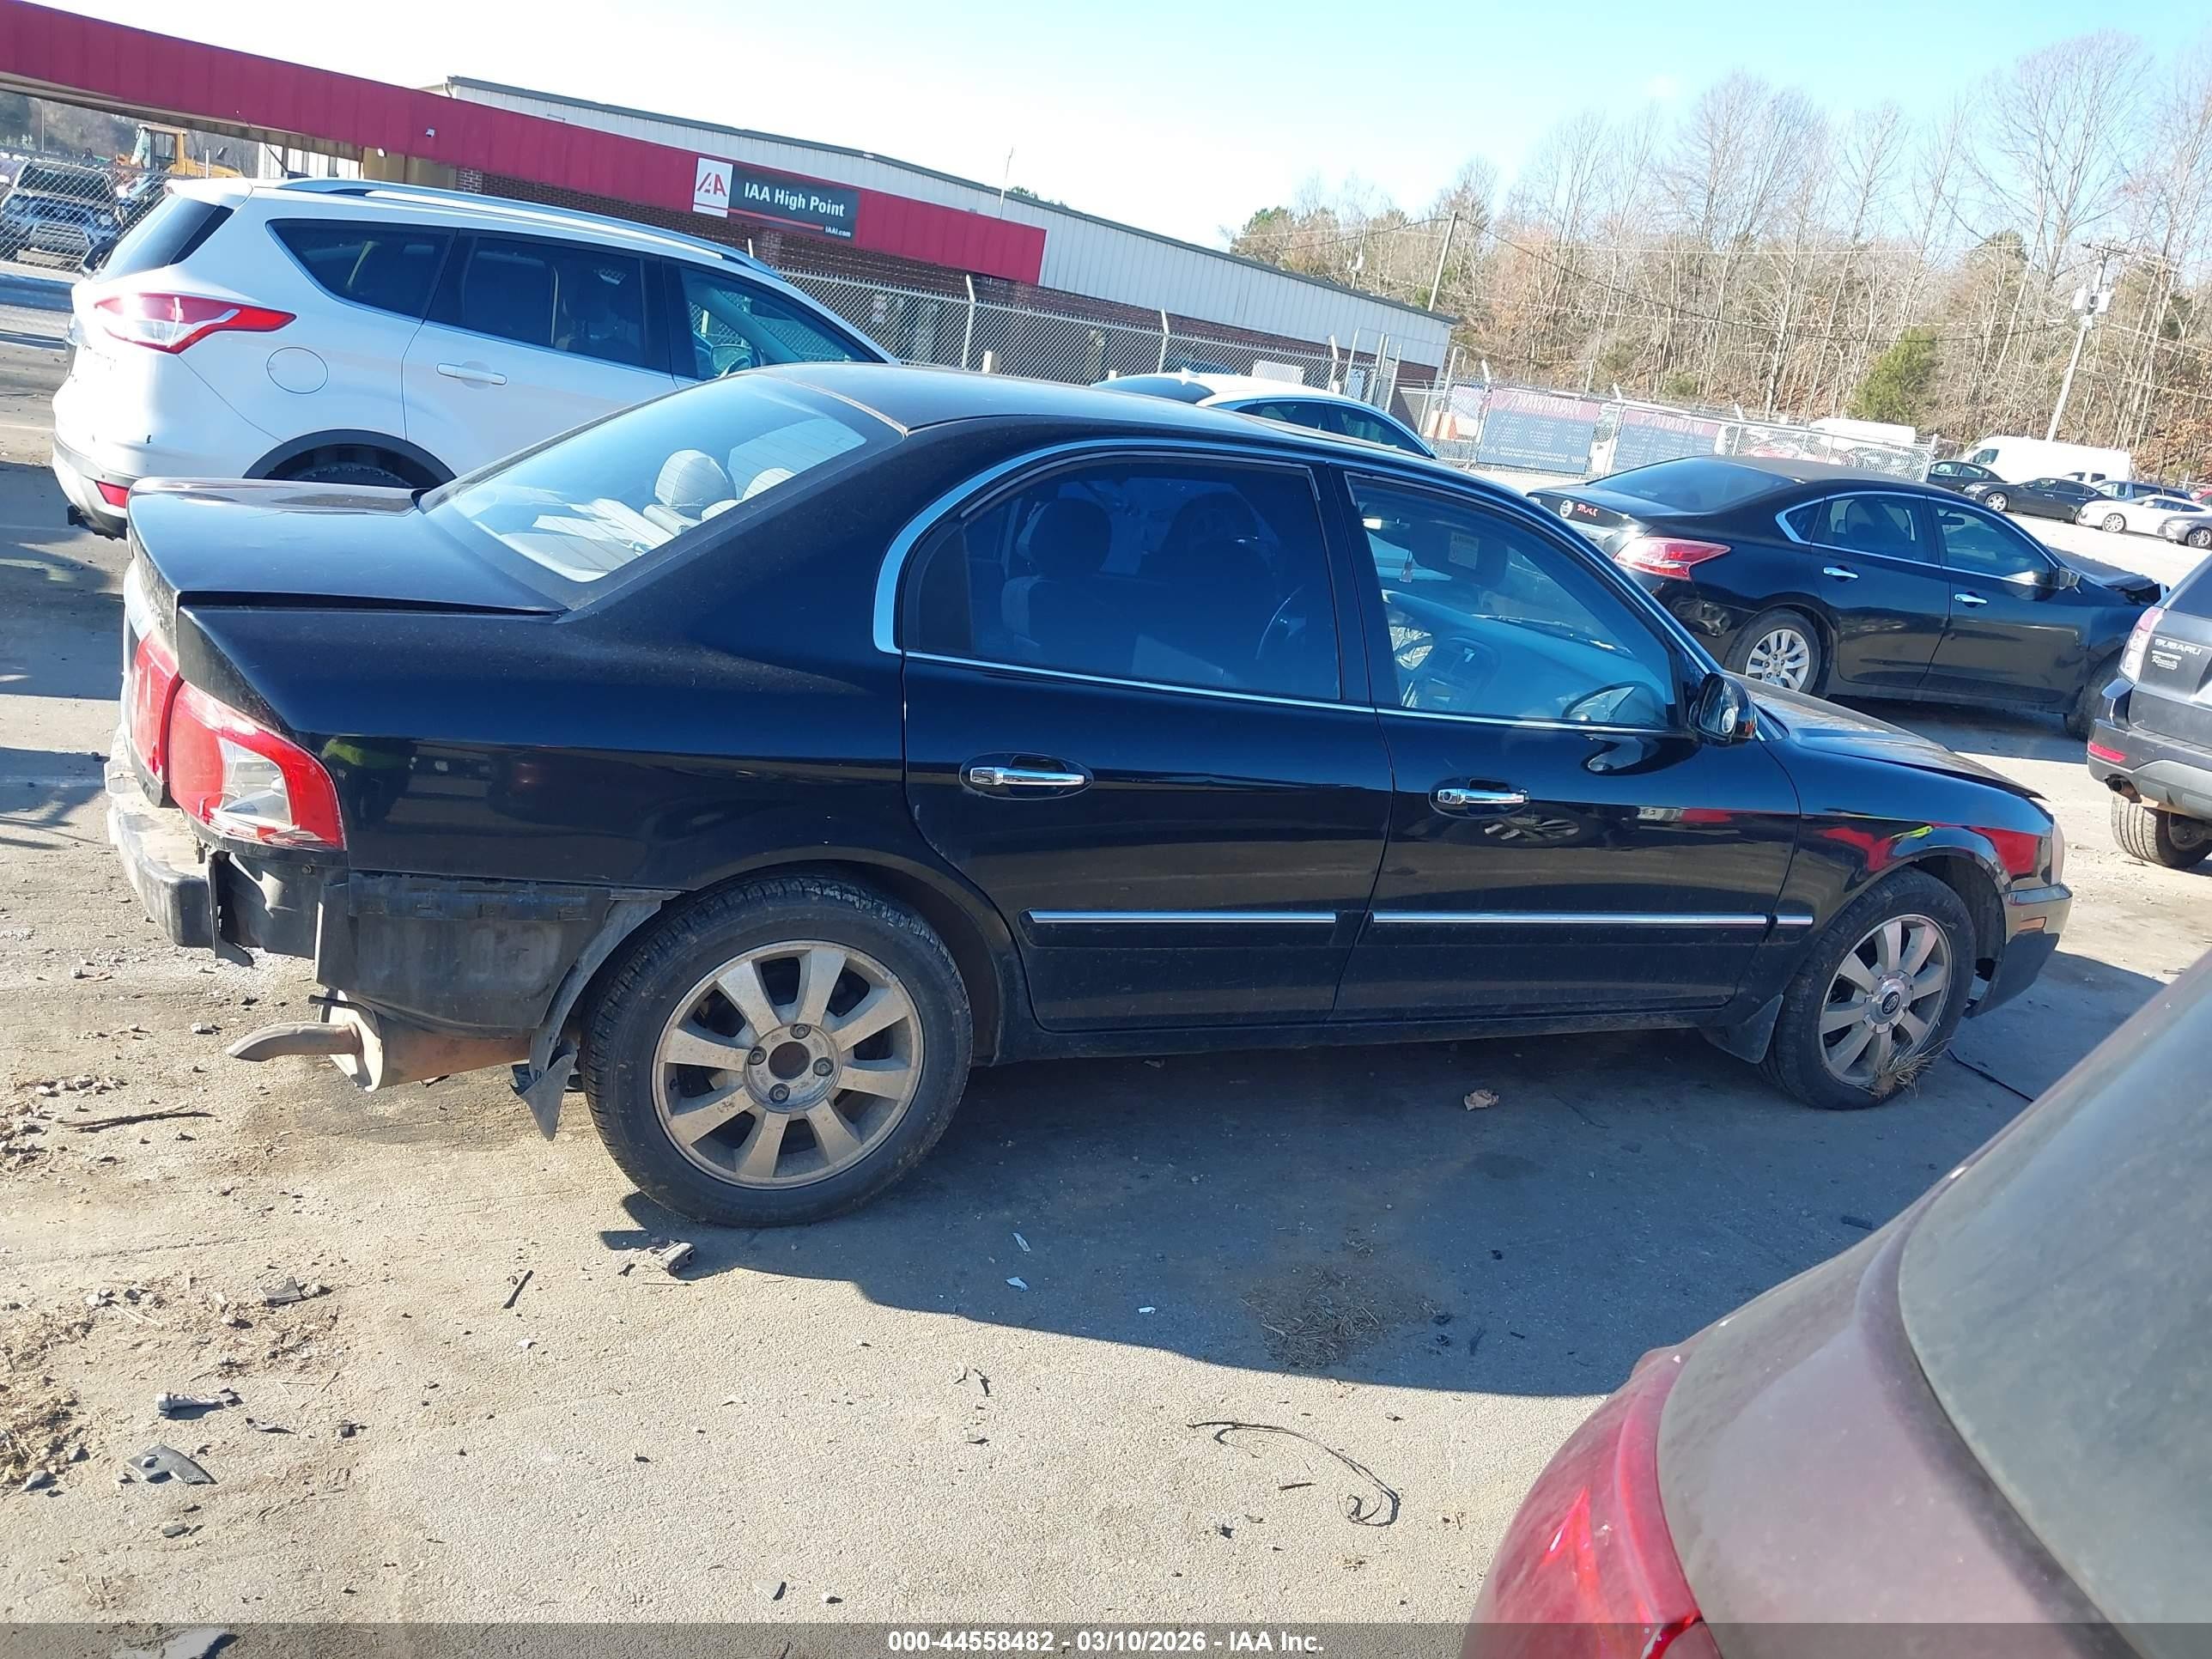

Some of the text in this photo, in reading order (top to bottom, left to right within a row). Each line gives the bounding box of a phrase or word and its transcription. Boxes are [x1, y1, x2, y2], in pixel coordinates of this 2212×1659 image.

[744, 182, 845, 217] IAA High Point
[2154, 638, 2203, 655] SUBARU
